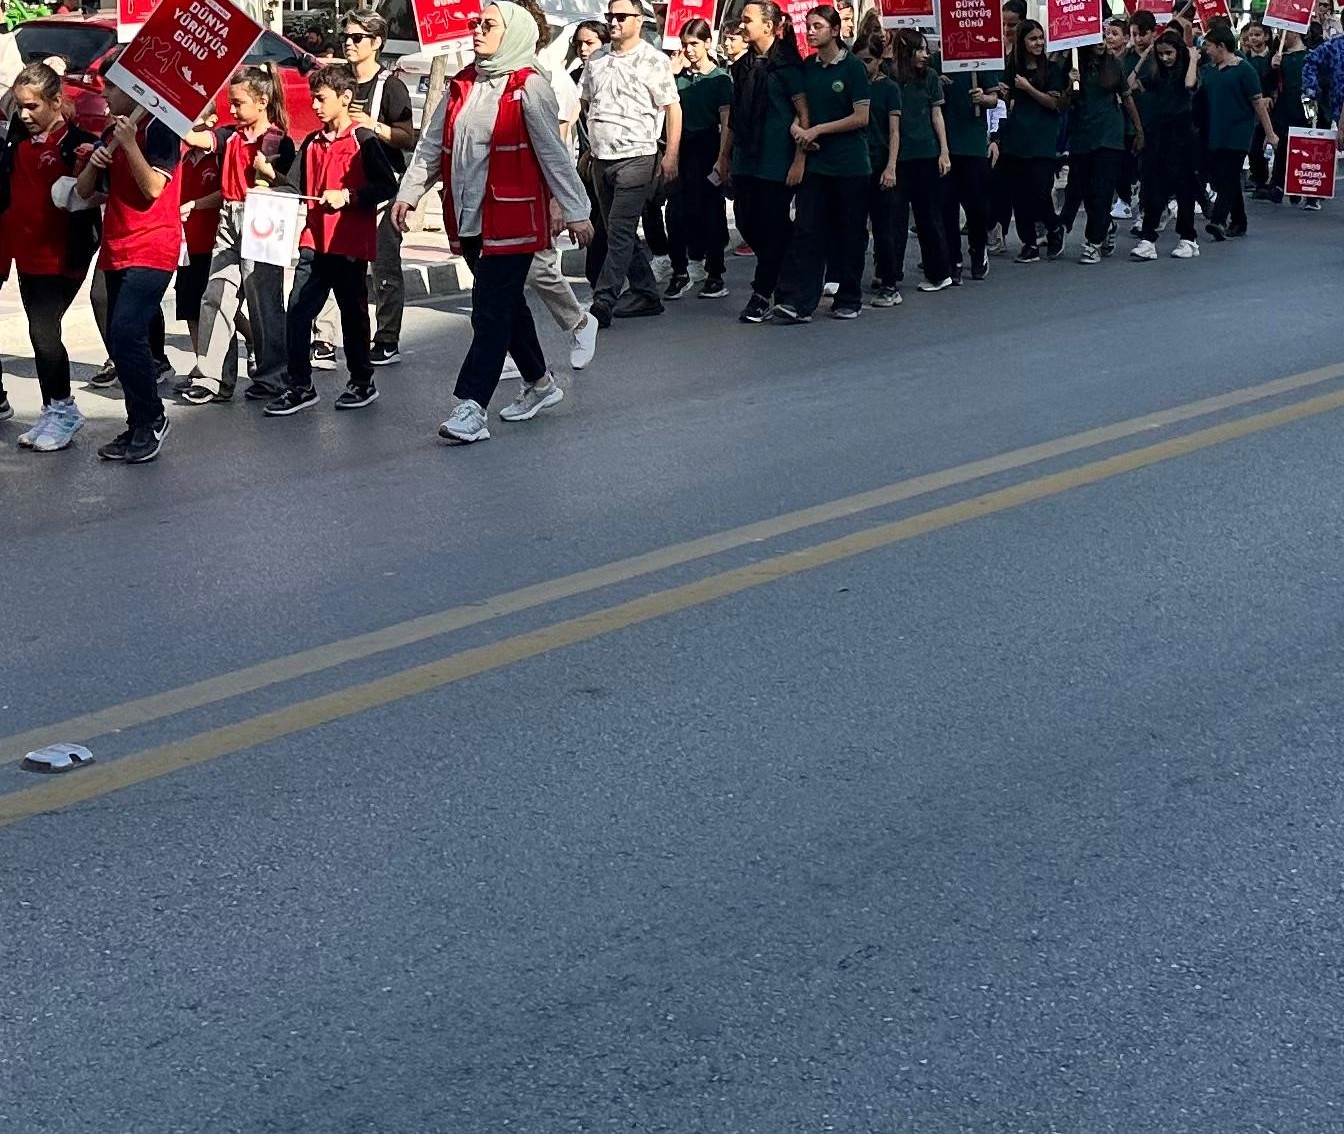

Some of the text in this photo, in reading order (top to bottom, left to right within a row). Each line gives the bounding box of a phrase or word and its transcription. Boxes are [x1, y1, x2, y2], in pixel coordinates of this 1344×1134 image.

[172, 7, 229, 59] YÜRÜYÜŞ
[189, 1, 230, 39] DÜNYA
[173, 29, 209, 61] GÜNÜ
